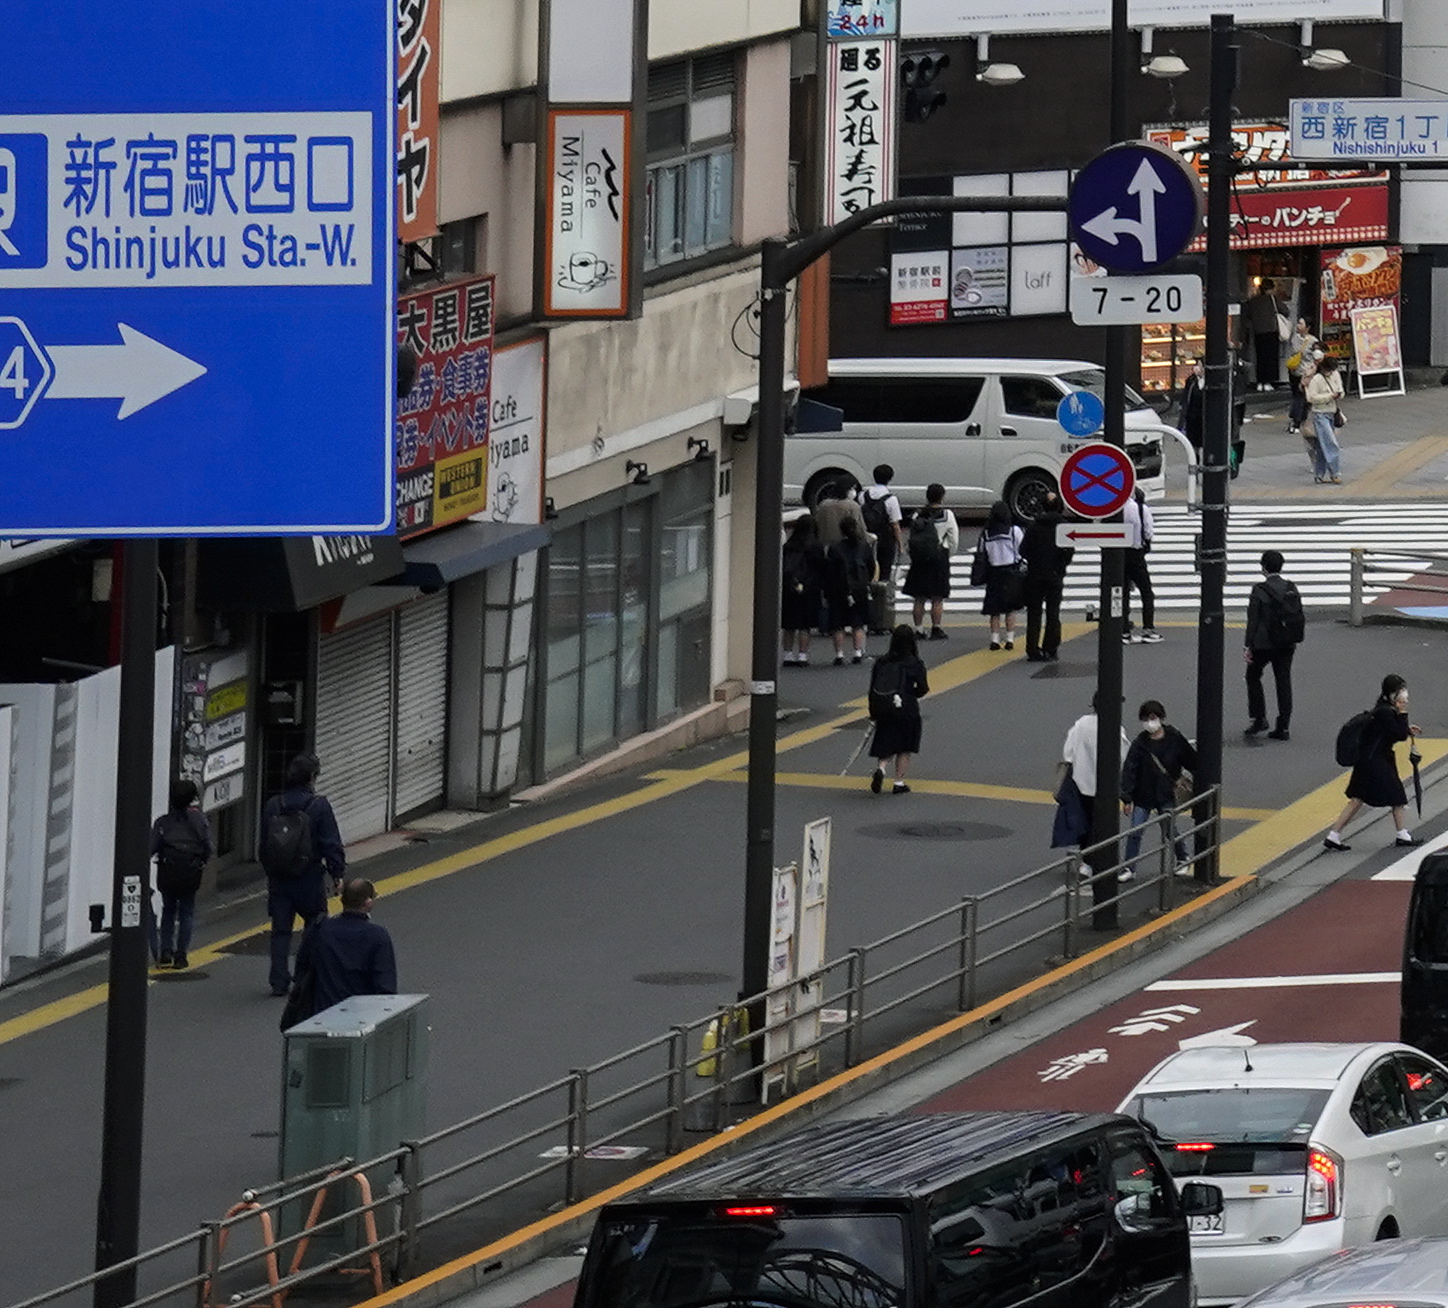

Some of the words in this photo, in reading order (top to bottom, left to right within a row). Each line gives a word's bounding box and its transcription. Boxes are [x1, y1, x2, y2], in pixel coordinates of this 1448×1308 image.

[838, 13, 886, 32] 24h
[838, 48, 883, 73] 廻る
[1301, 101, 1346, 115] 新宿区
[1332, 140, 1429, 160] Nishishinjuku
[63, 131, 356, 219] 新宿駅西口
[559, 137, 581, 234] Miyama
[585, 162, 597, 210] Cafe
[65, 223, 227, 281] Shinjuku
[241, 223, 359, 269] Sta.-W.
[397, 282, 493, 358] 大黒屋
[490, 433, 530, 468] iyama
